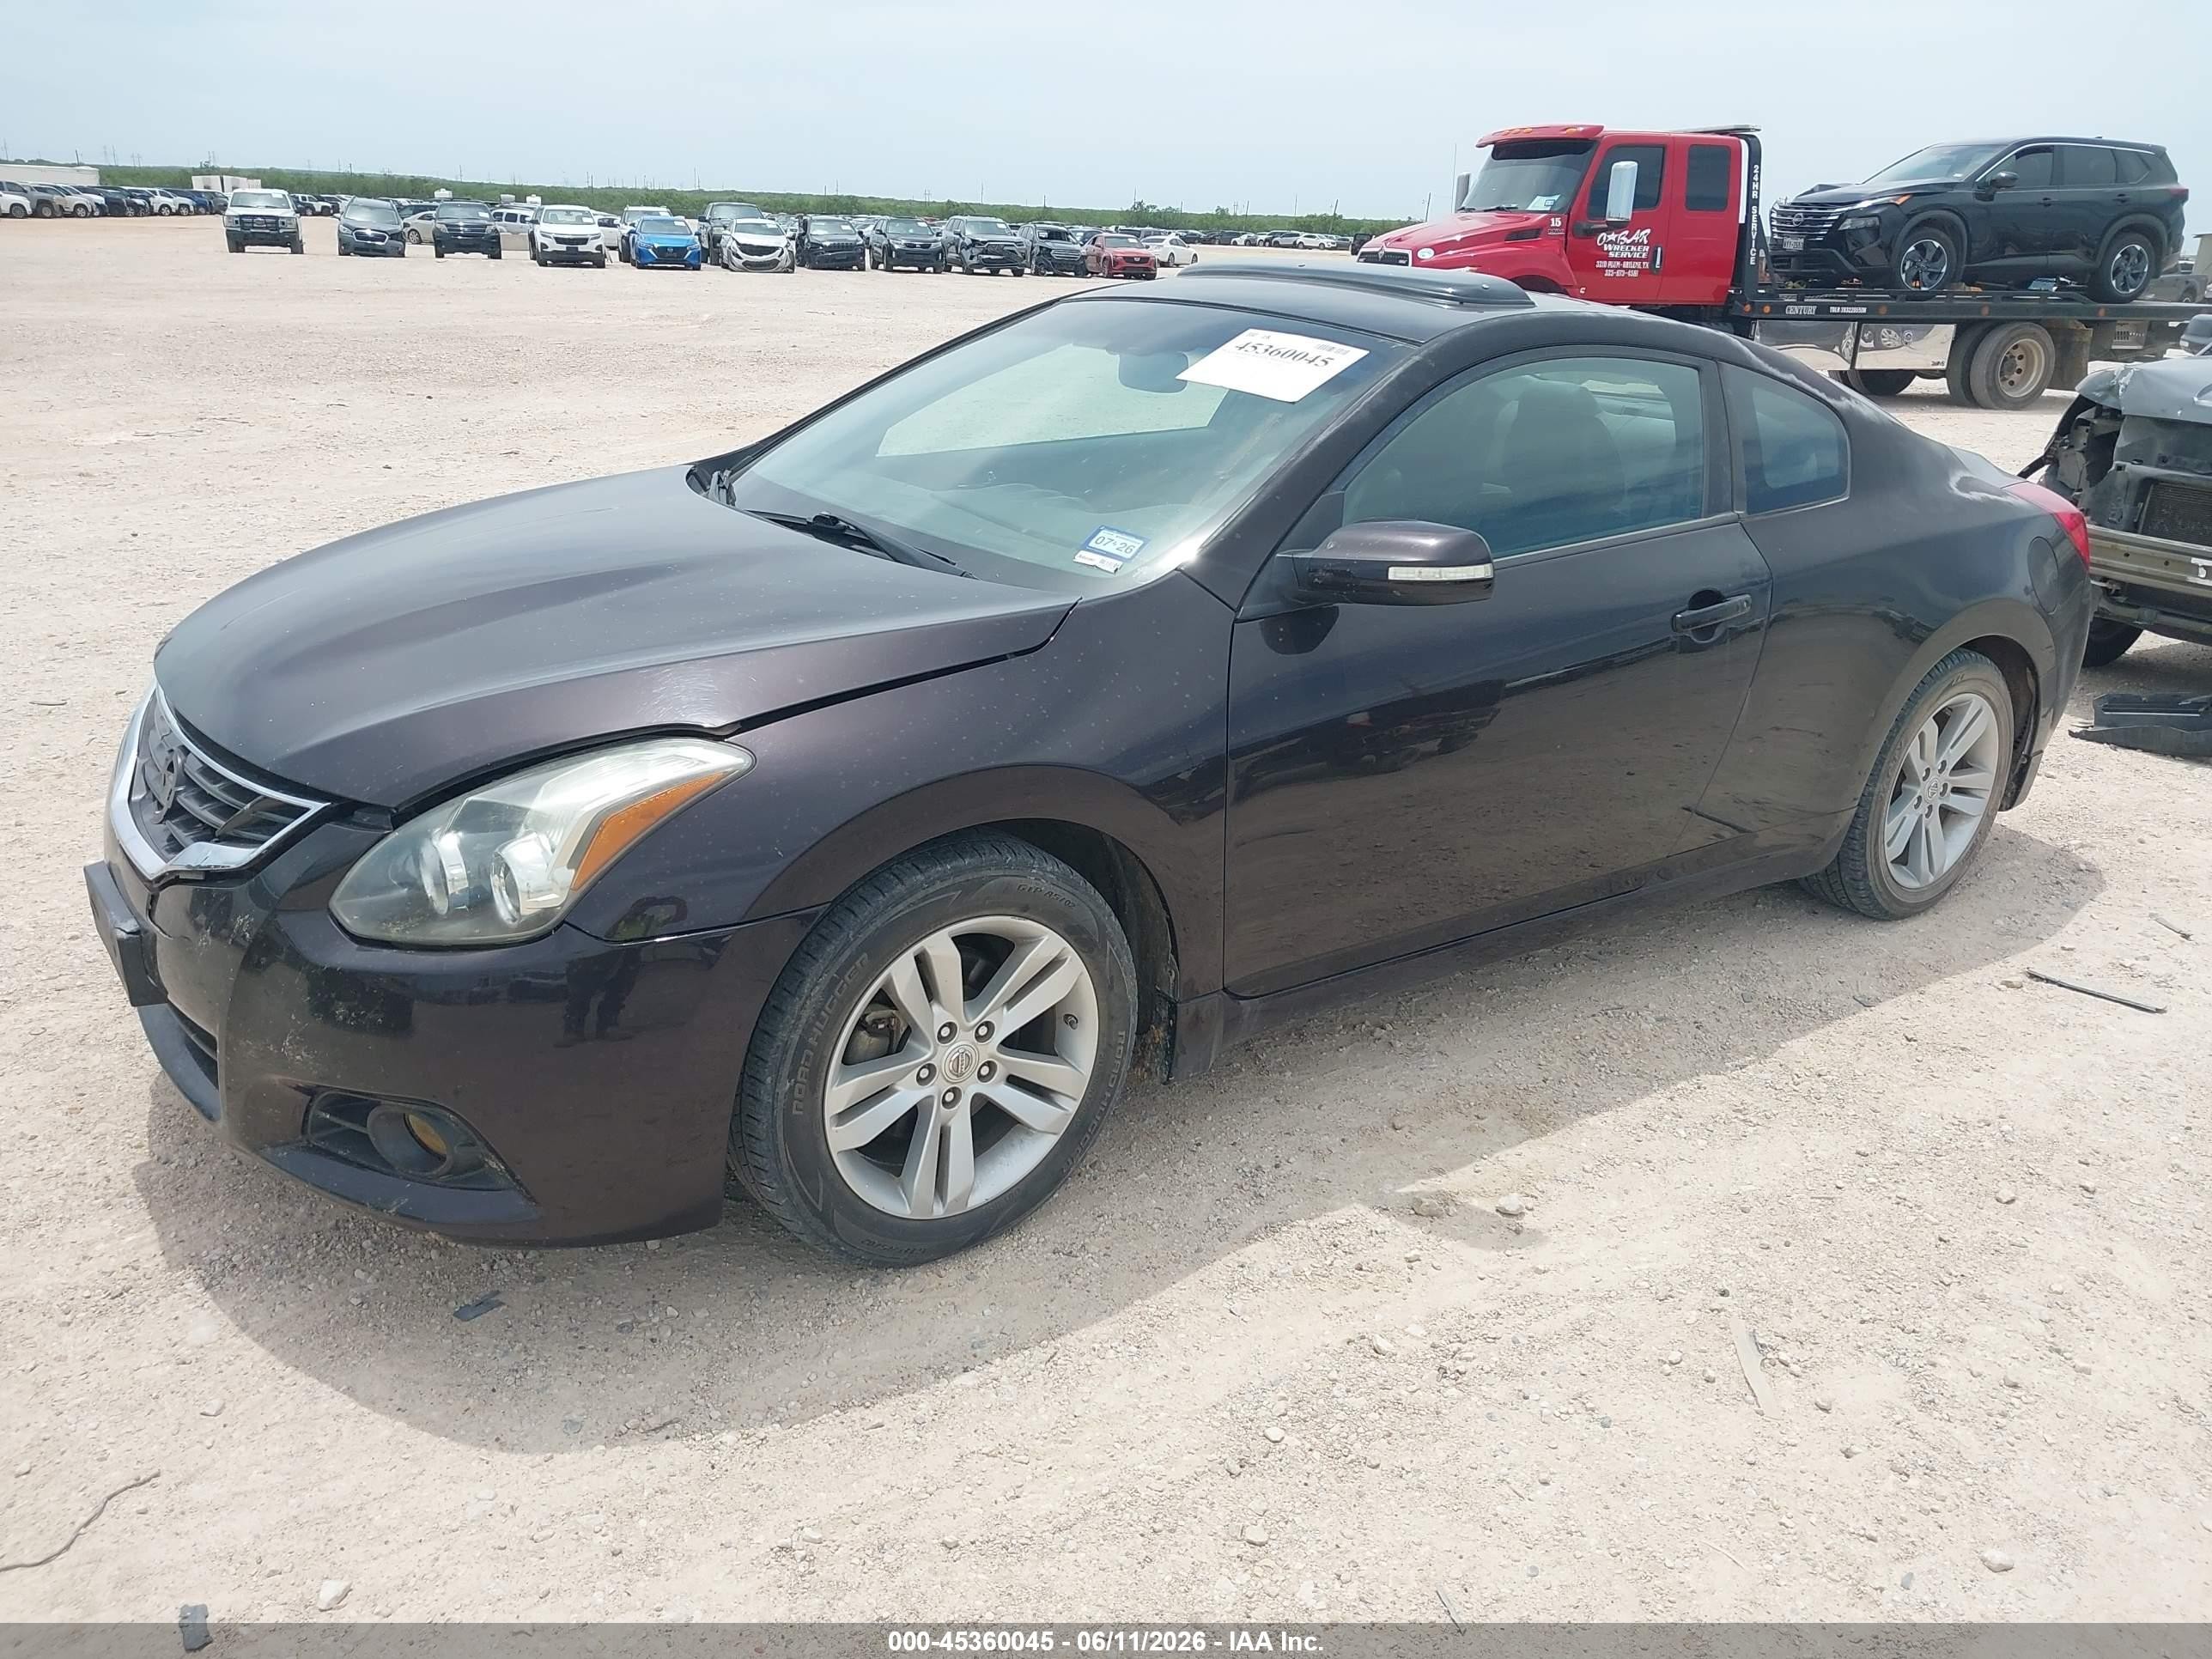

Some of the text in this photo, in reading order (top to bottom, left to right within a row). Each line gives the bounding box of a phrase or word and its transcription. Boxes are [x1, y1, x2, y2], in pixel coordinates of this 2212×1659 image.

[1550, 217, 1562, 228] 15
[1603, 243, 1650, 252] WRECKER
[1785, 305, 1818, 315] CENTURY
[1235, 341, 1334, 368] 45360045
[1094, 536, 1115, 546] 07
[1115, 542, 1135, 555] 26
